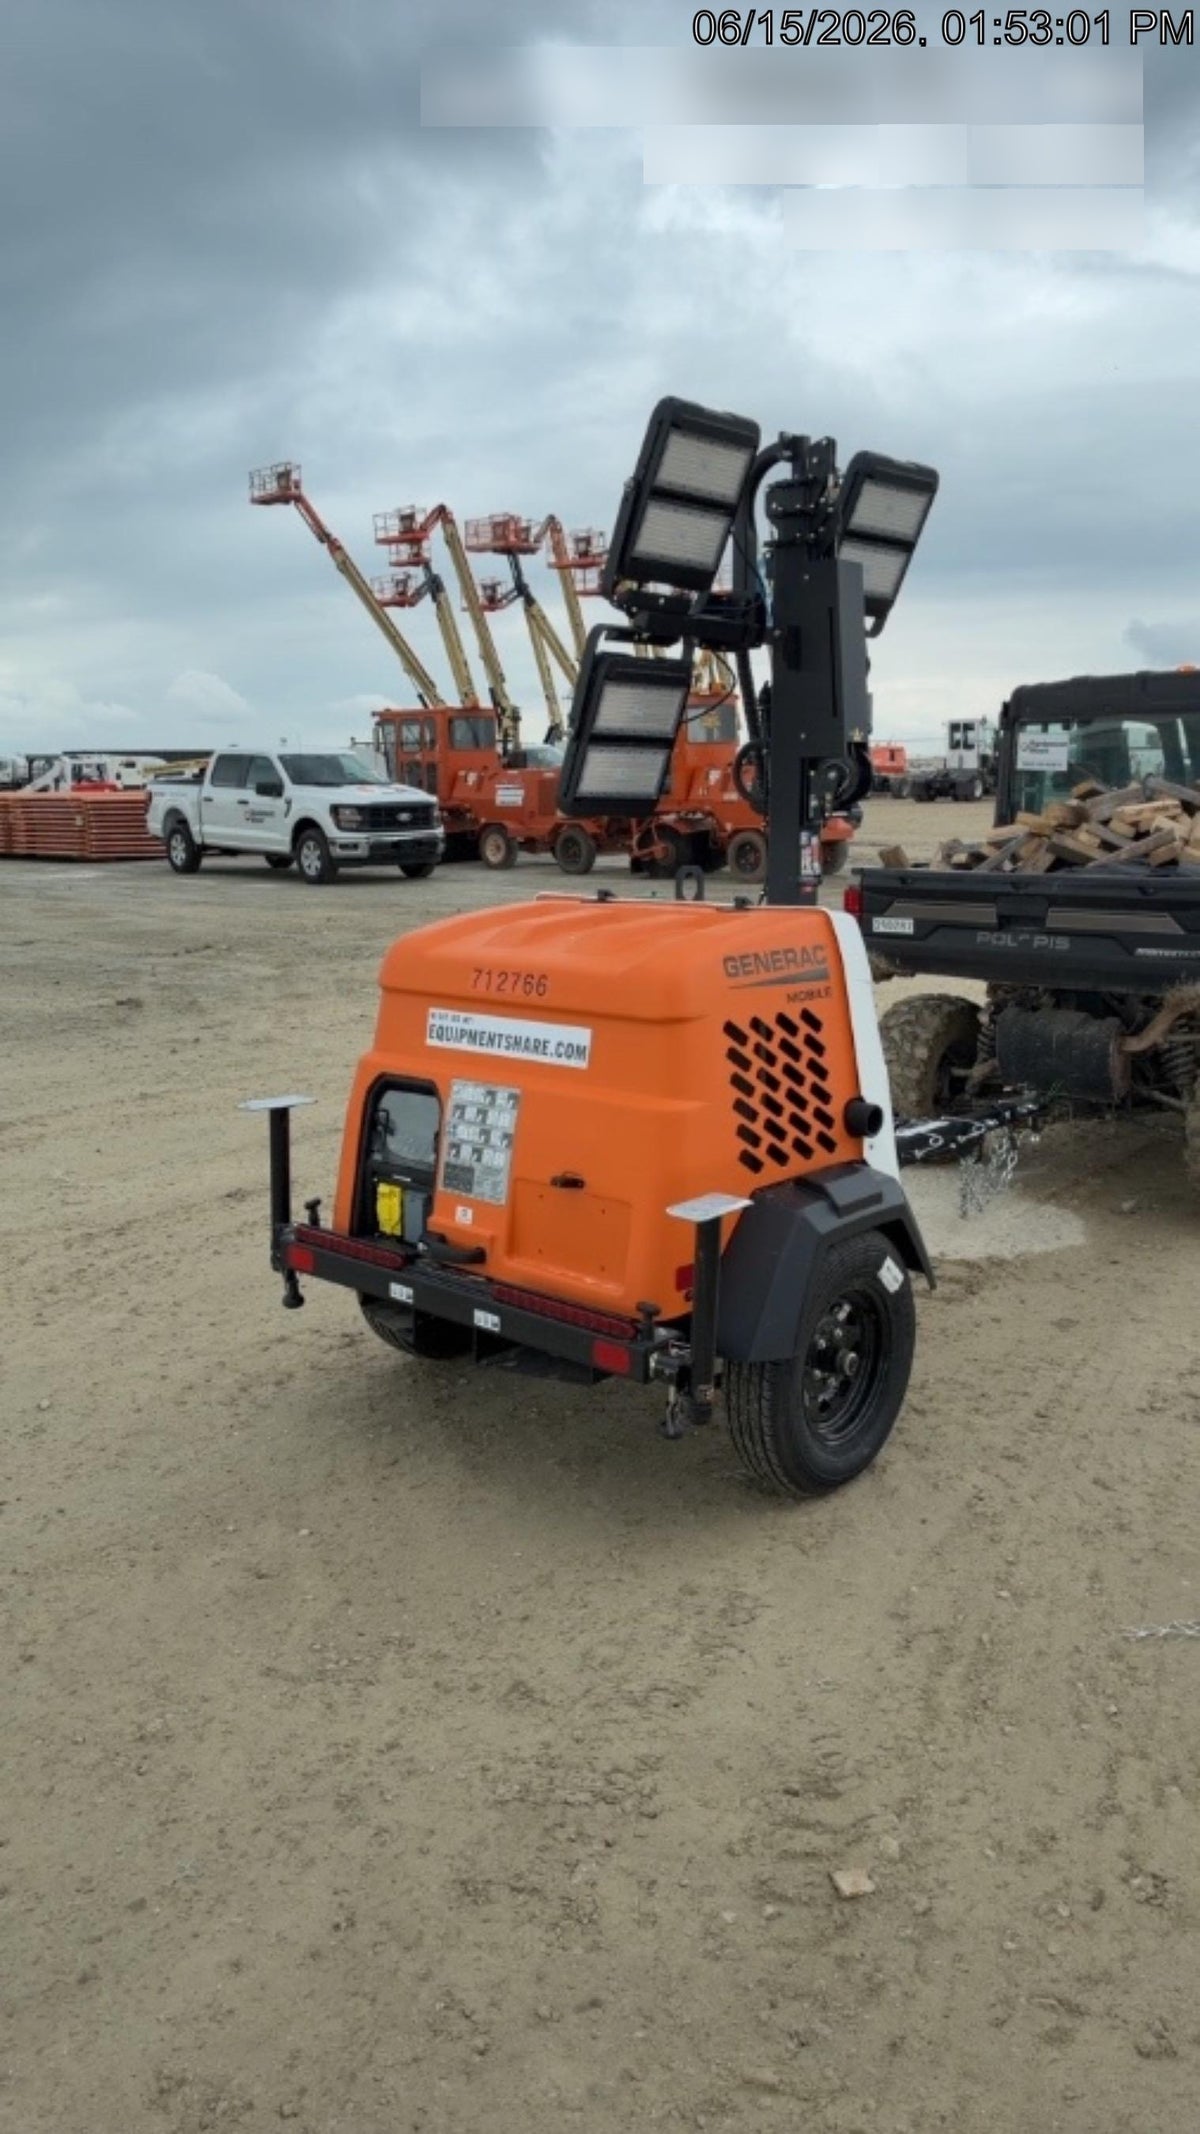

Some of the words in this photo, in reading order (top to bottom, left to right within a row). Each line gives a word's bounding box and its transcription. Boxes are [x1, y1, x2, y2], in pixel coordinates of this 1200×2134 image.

[723, 945, 827, 977] GENERAC
[472, 968, 548, 997] 712766
[786, 987, 831, 1003] MOBILE
[428, 1024, 587, 1061] EQUIPMENTSHARE.COM
